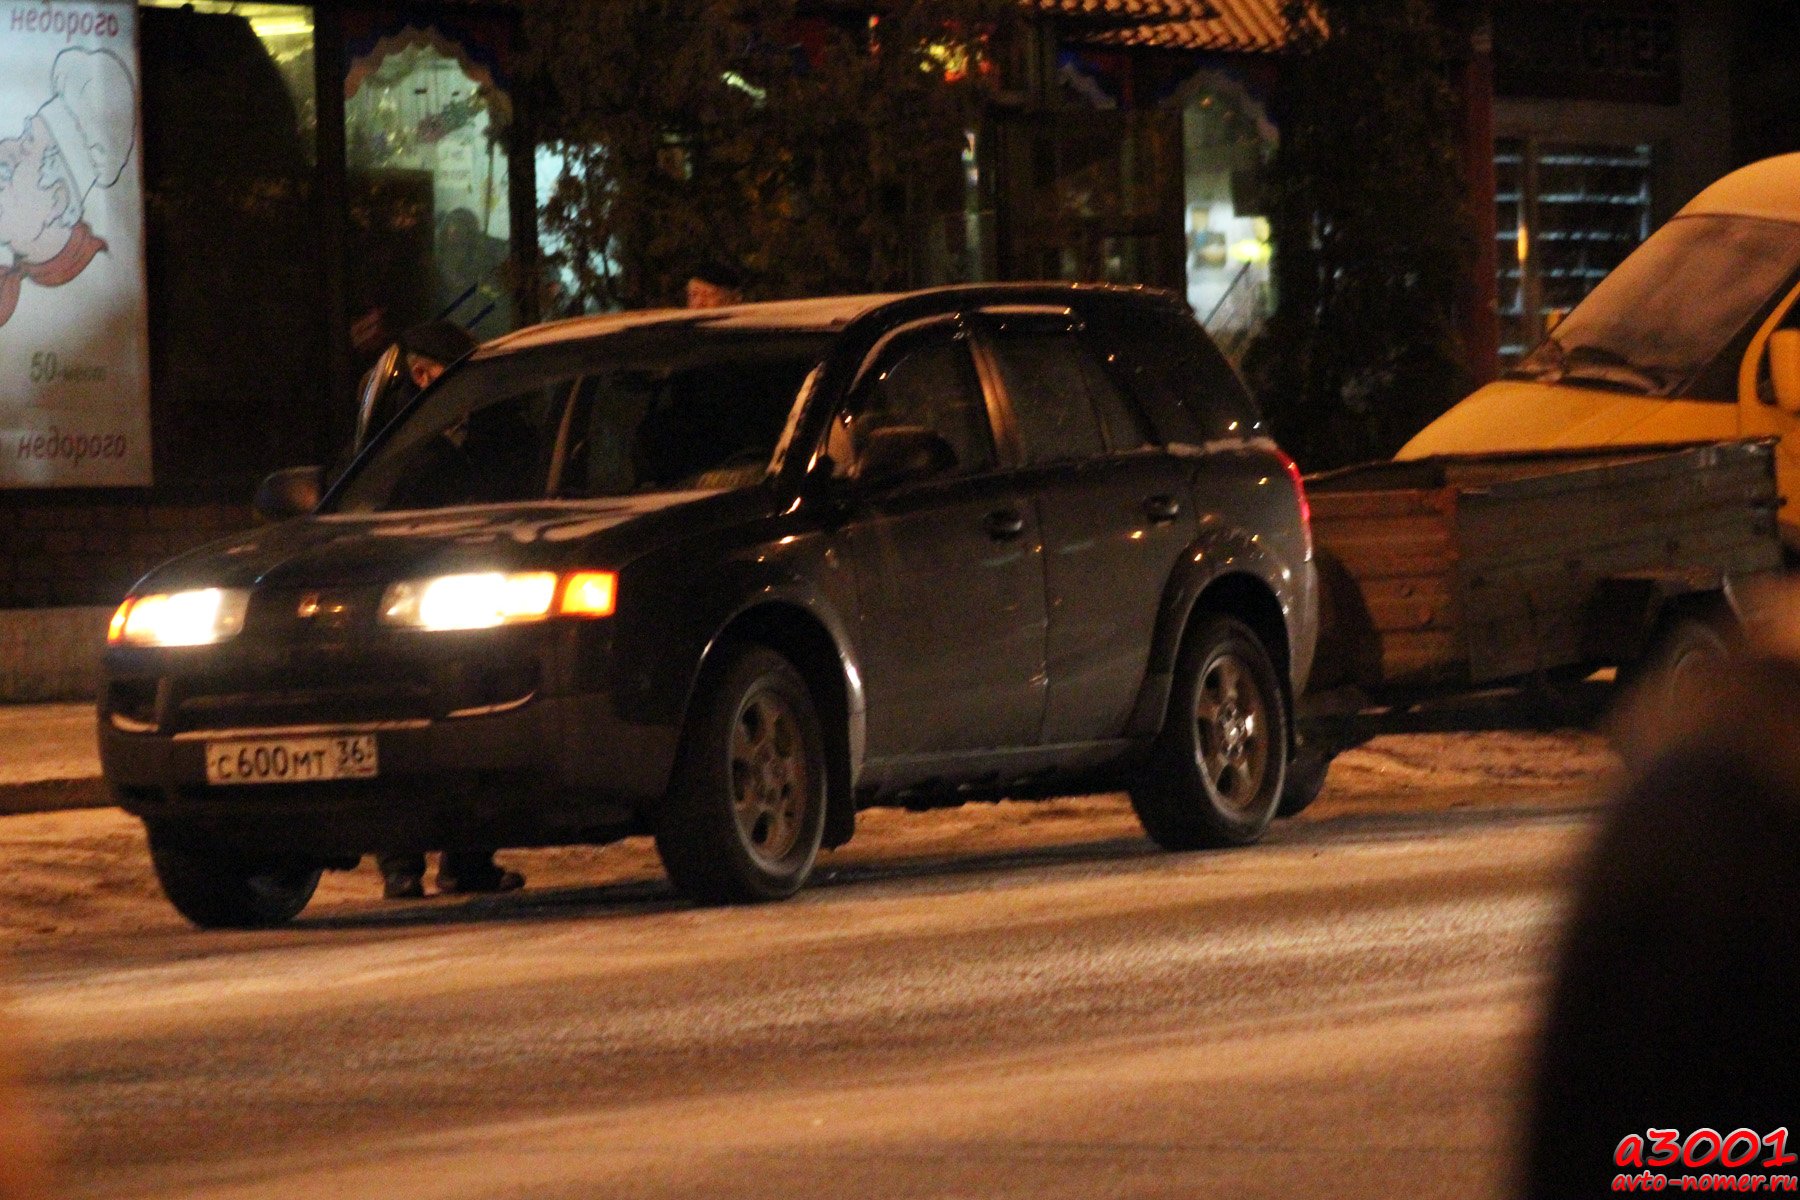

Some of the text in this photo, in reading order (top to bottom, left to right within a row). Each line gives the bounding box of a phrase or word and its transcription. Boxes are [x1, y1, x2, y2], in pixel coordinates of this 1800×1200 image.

[9, 5, 120, 43] недорого
[29, 351, 59, 383] 50
[17, 425, 127, 467] недорого
